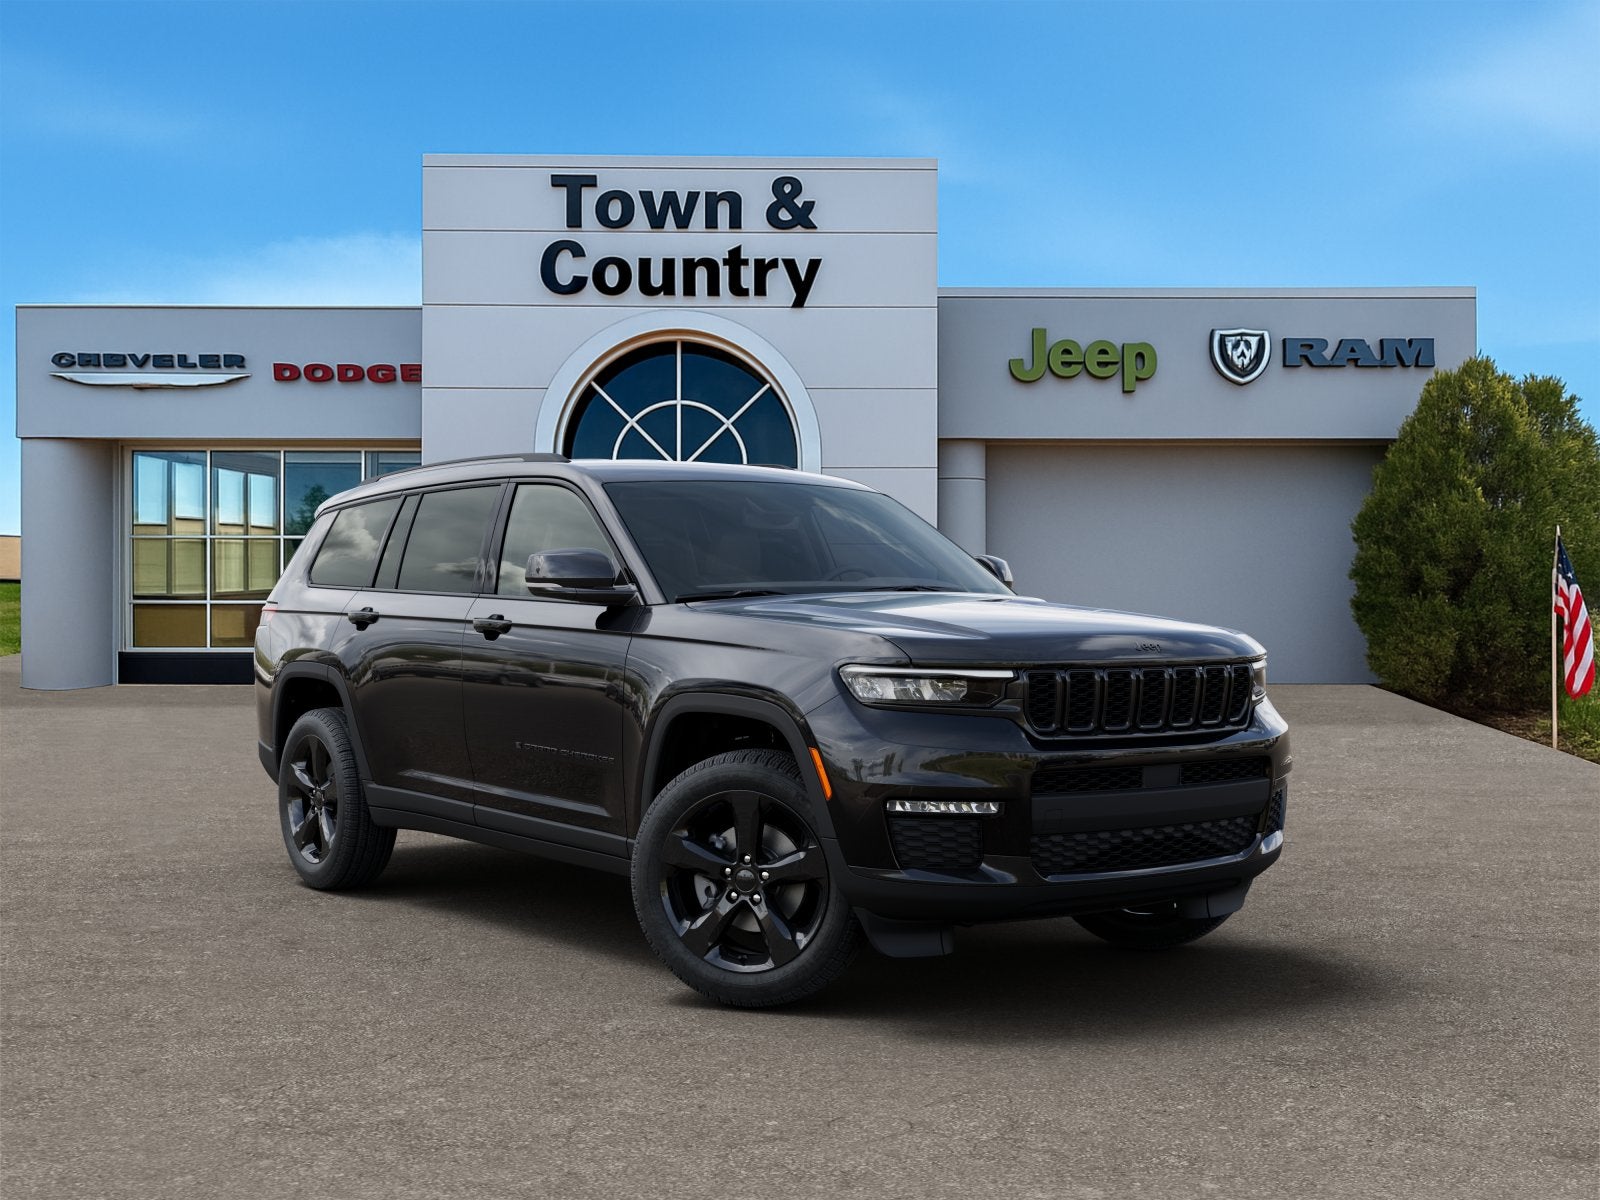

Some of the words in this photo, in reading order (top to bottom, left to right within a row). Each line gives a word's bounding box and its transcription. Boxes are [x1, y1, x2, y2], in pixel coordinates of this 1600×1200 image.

[550, 173, 742, 230] Town
[765, 175, 818, 230] &
[540, 239, 822, 308] Country
[273, 363, 422, 384] DODGE
[1009, 327, 1157, 393] Jeep
[1282, 337, 1435, 368] RAM
